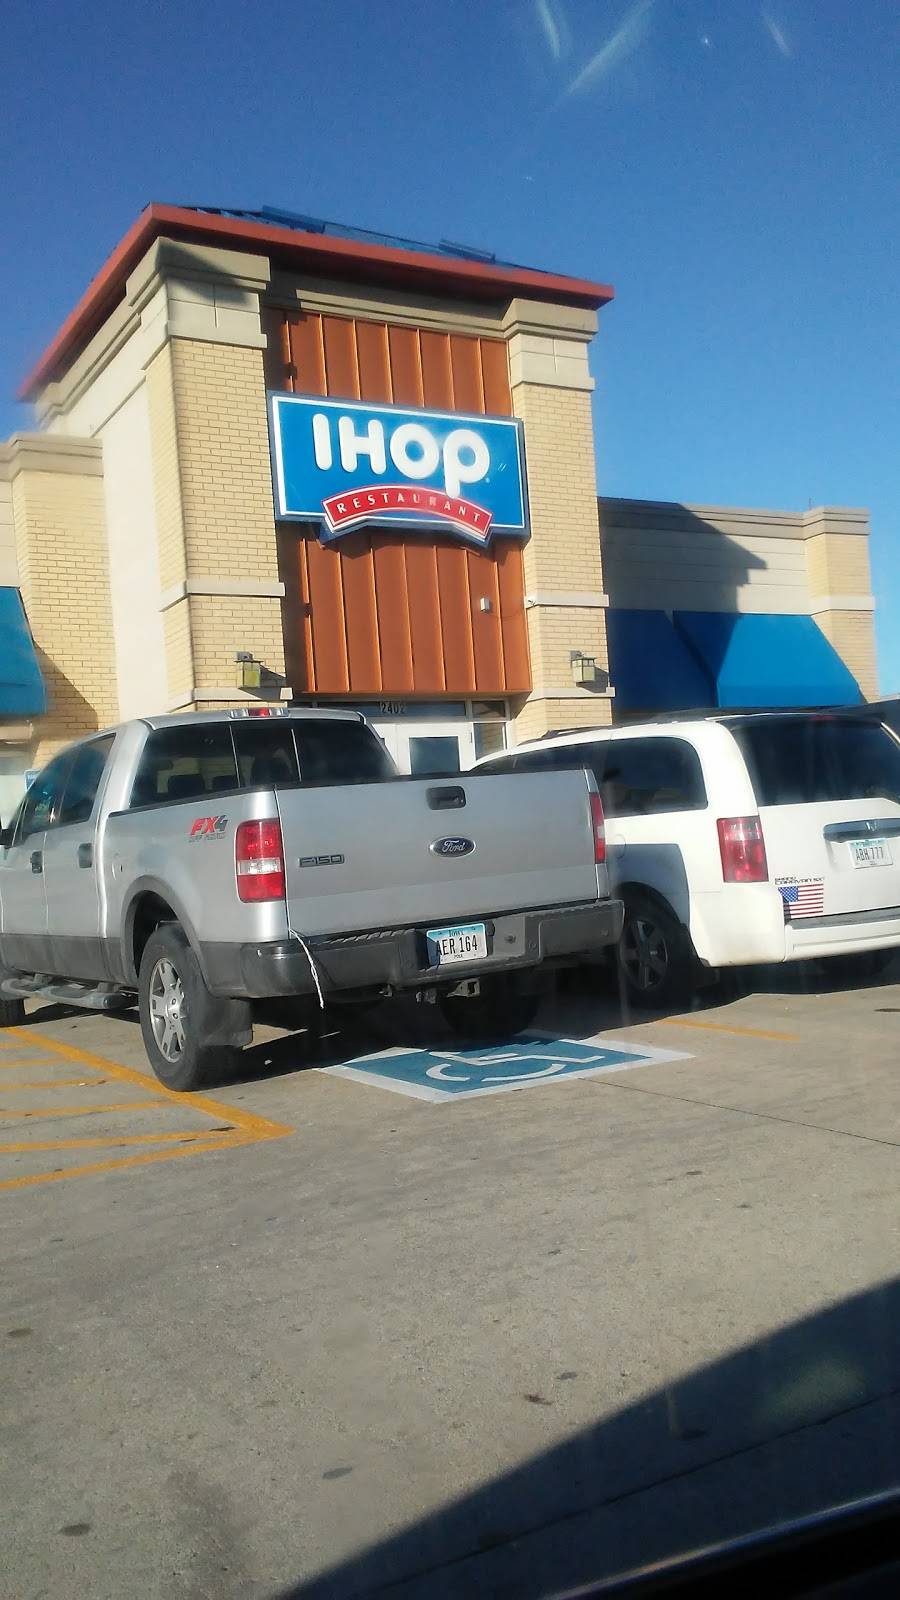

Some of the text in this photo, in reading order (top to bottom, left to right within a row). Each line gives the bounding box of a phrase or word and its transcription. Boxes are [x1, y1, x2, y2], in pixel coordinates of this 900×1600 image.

[312, 413, 490, 499] IHOP
[336, 491, 481, 523] RESTAURANT
[191, 814, 228, 836] FX4
[870, 846, 884, 859] 777
[437, 935, 478, 955] AER 164
